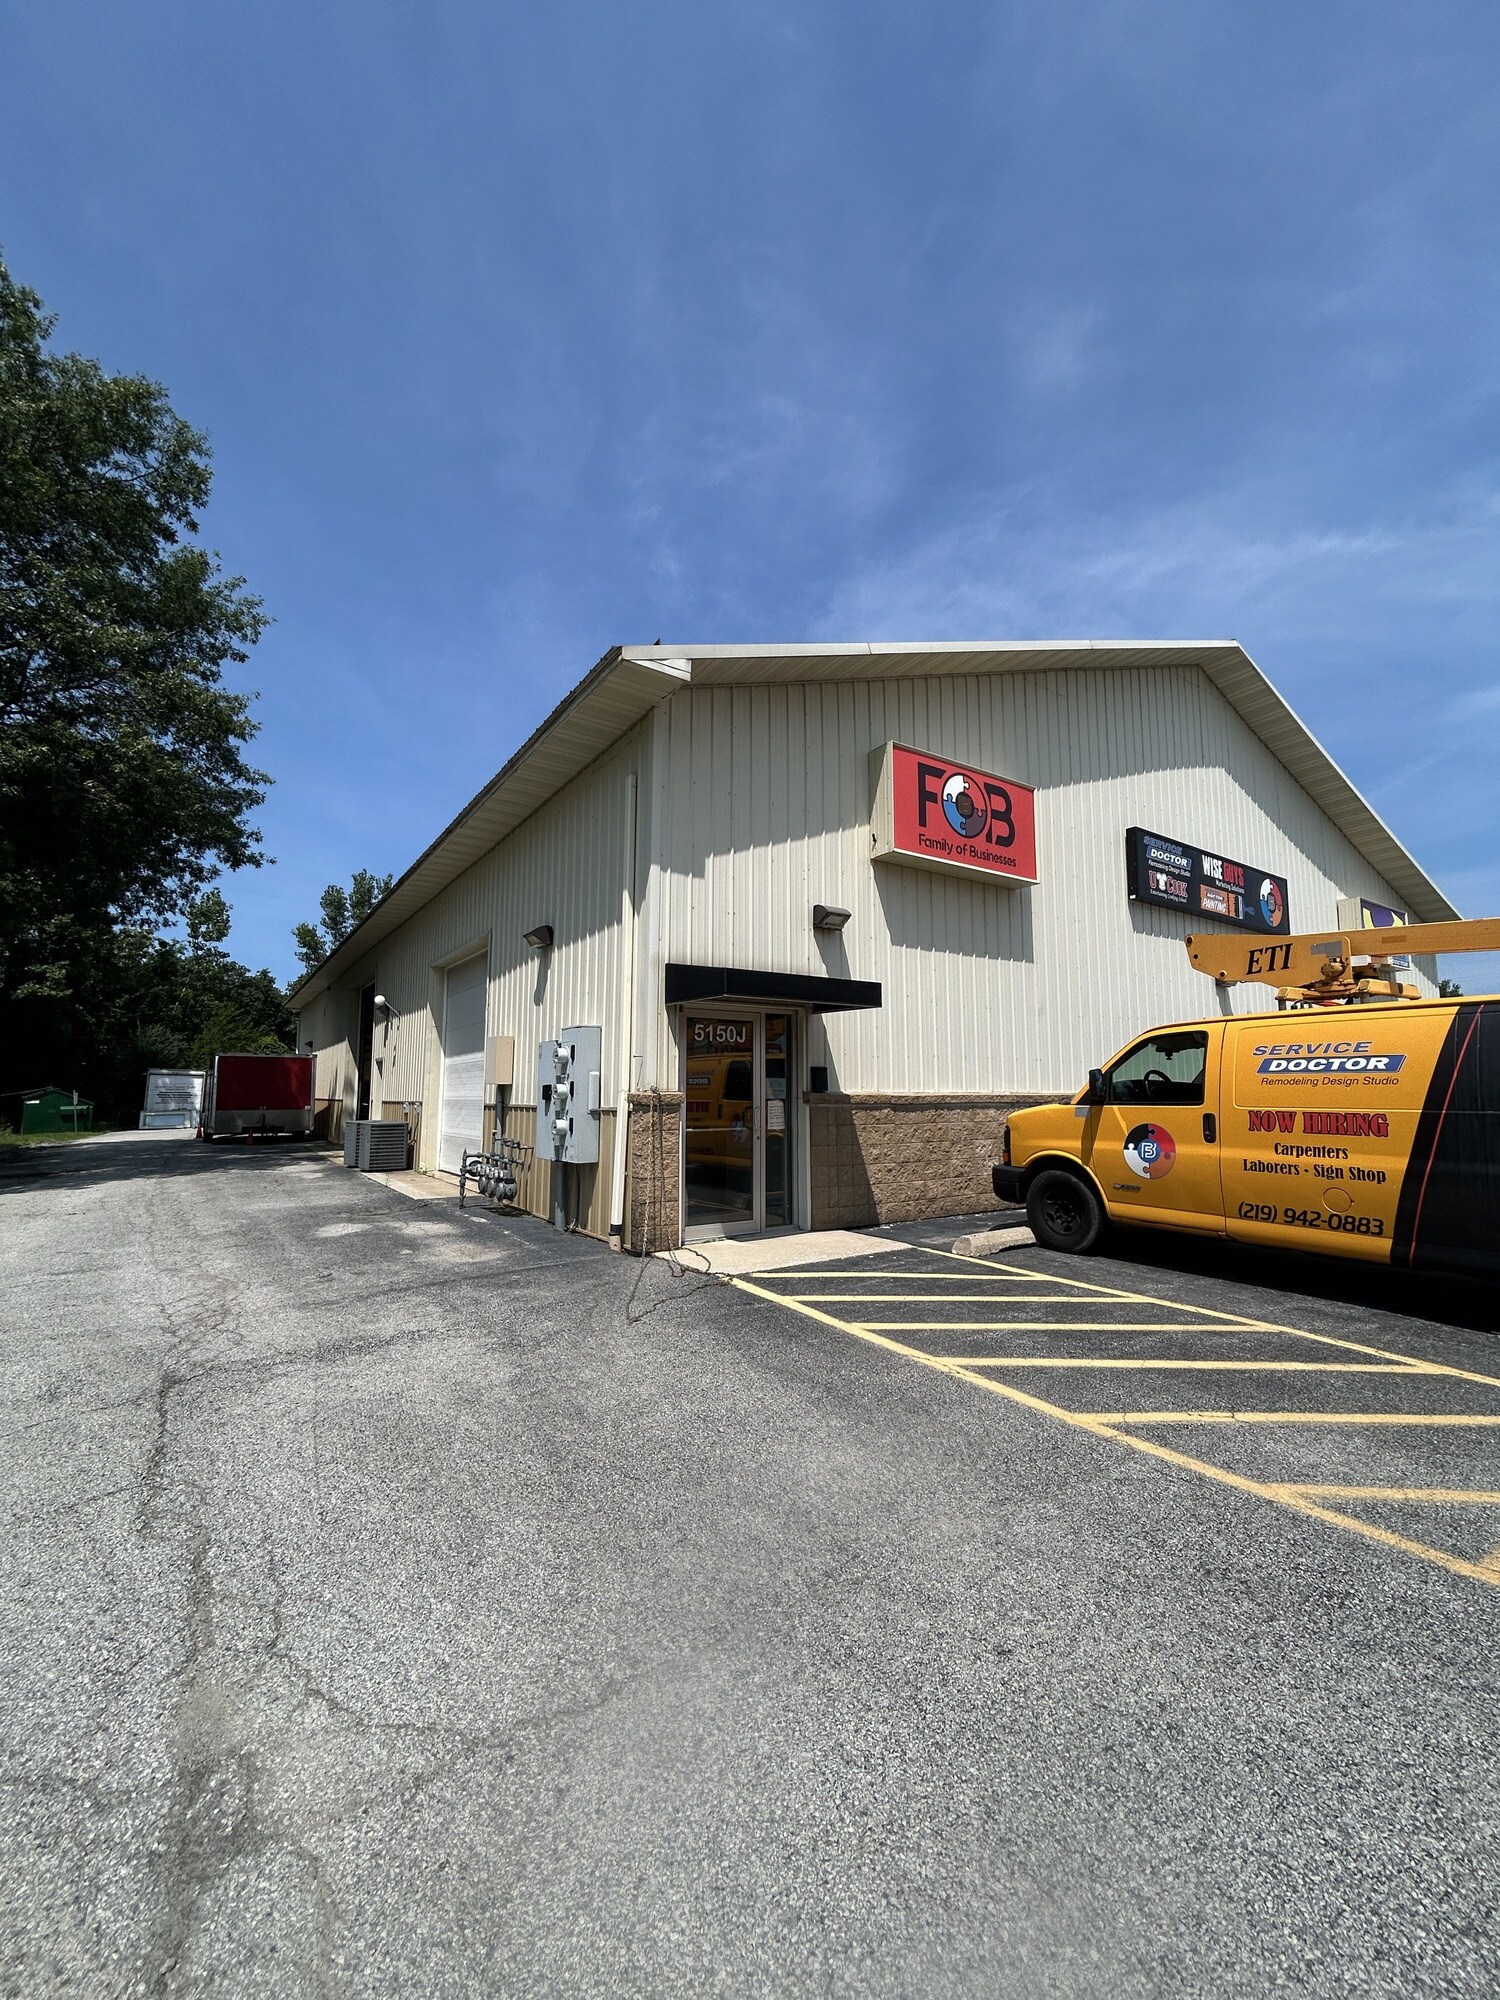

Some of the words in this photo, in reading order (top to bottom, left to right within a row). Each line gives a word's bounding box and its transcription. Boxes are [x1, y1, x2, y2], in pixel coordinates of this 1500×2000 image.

[918, 833, 953, 856] Family
[956, 842, 968, 856] of
[970, 845, 1017, 868] Businesses
[1144, 836, 1182, 855] SERVICE
[1150, 848, 1188, 867] DOCTOR
[1202, 854, 1223, 880] WISE
[1223, 861, 1244, 887] GUYS
[1202, 898, 1226, 913] PAINTING
[1246, 942, 1294, 976] ETI
[694, 1024, 746, 1044] 5150J
[1252, 1041, 1373, 1056] SERVICE
[1268, 1057, 1390, 1072] DOCTOR
[1260, 1077, 1319, 1088] Remodeling
[1322, 1076, 1359, 1088] Design
[1362, 1076, 1400, 1086] Studio
[1248, 1110, 1297, 1134] NOW
[1302, 1111, 1390, 1138] HIRING
[1274, 1142, 1349, 1160] Carpenters
[1243, 1159, 1300, 1176] Laborers
[1314, 1164, 1344, 1182] Sign
[1348, 1166, 1387, 1184] Shop
[1238, 1201, 1278, 1224] (219)
[1284, 1208, 1384, 1236] 942-0883
